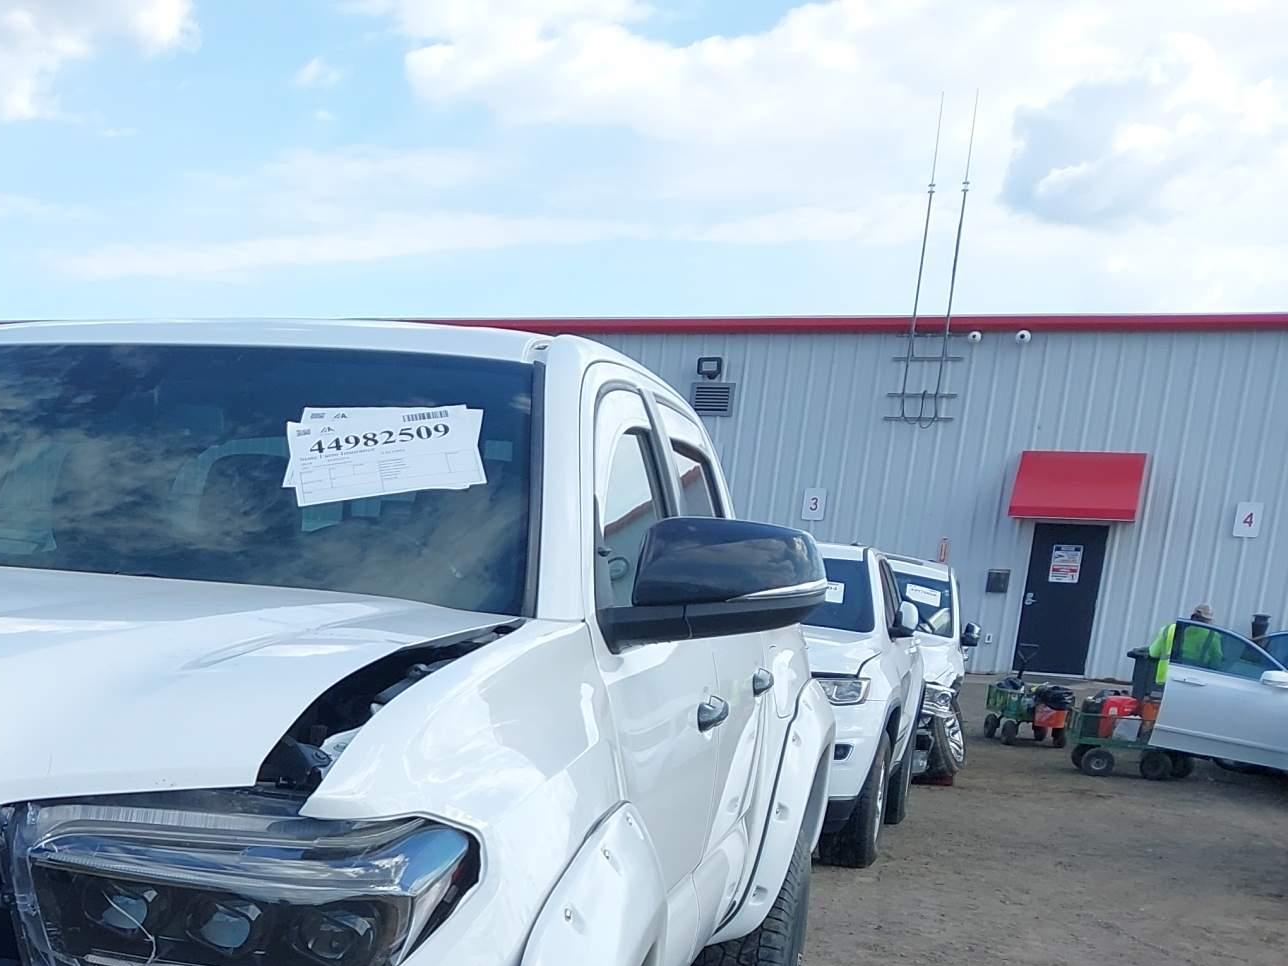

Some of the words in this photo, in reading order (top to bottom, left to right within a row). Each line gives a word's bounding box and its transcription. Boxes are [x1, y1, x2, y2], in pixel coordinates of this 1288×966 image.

[309, 423, 450, 454] 44982509
[809, 497, 819, 511] 3
[1242, 512, 1254, 528] 4
